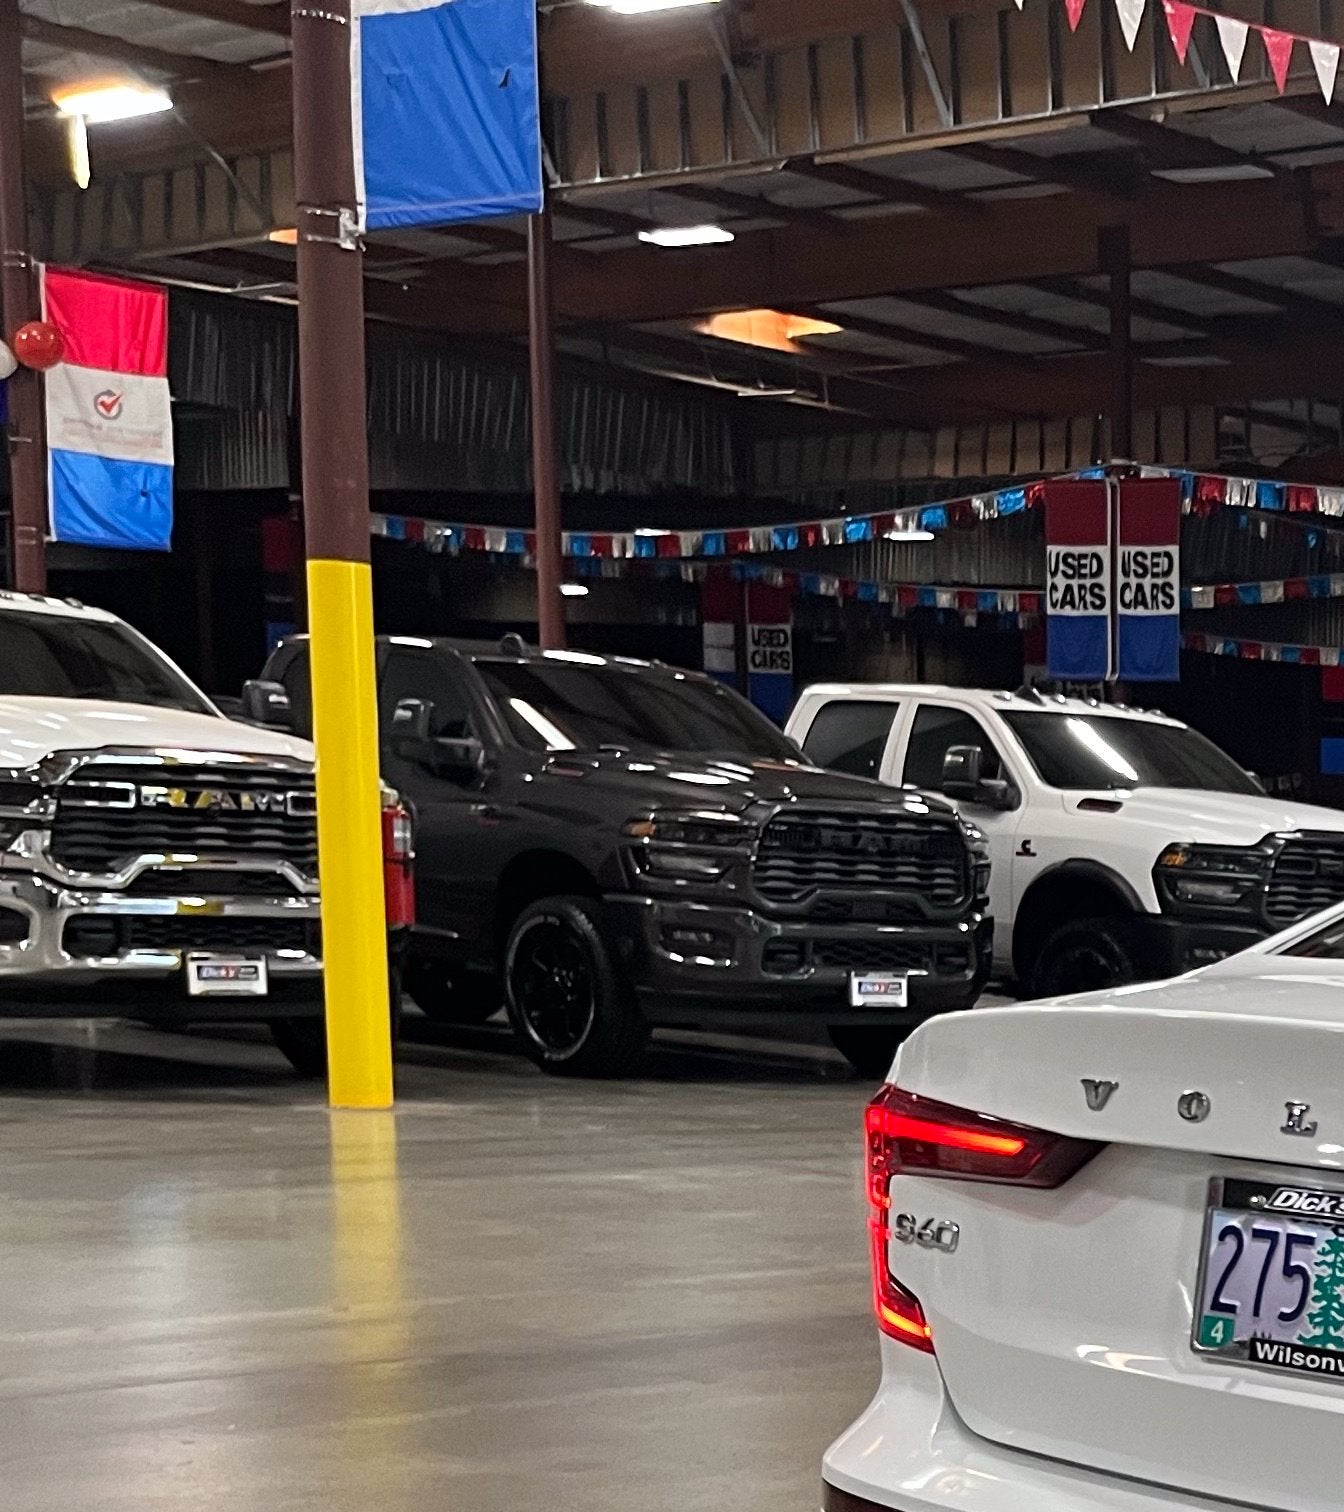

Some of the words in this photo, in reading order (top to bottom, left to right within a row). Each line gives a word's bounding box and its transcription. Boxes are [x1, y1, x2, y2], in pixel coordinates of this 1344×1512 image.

[1049, 551, 1104, 580] USED
[1121, 551, 1174, 579] USED
[1049, 582, 1107, 610] CARS
[1119, 582, 1175, 610] CARS
[752, 627, 789, 648] USED
[895, 1213, 960, 1254] S60
[1210, 1224, 1318, 1322] 275
[1210, 1319, 1225, 1343] 4
